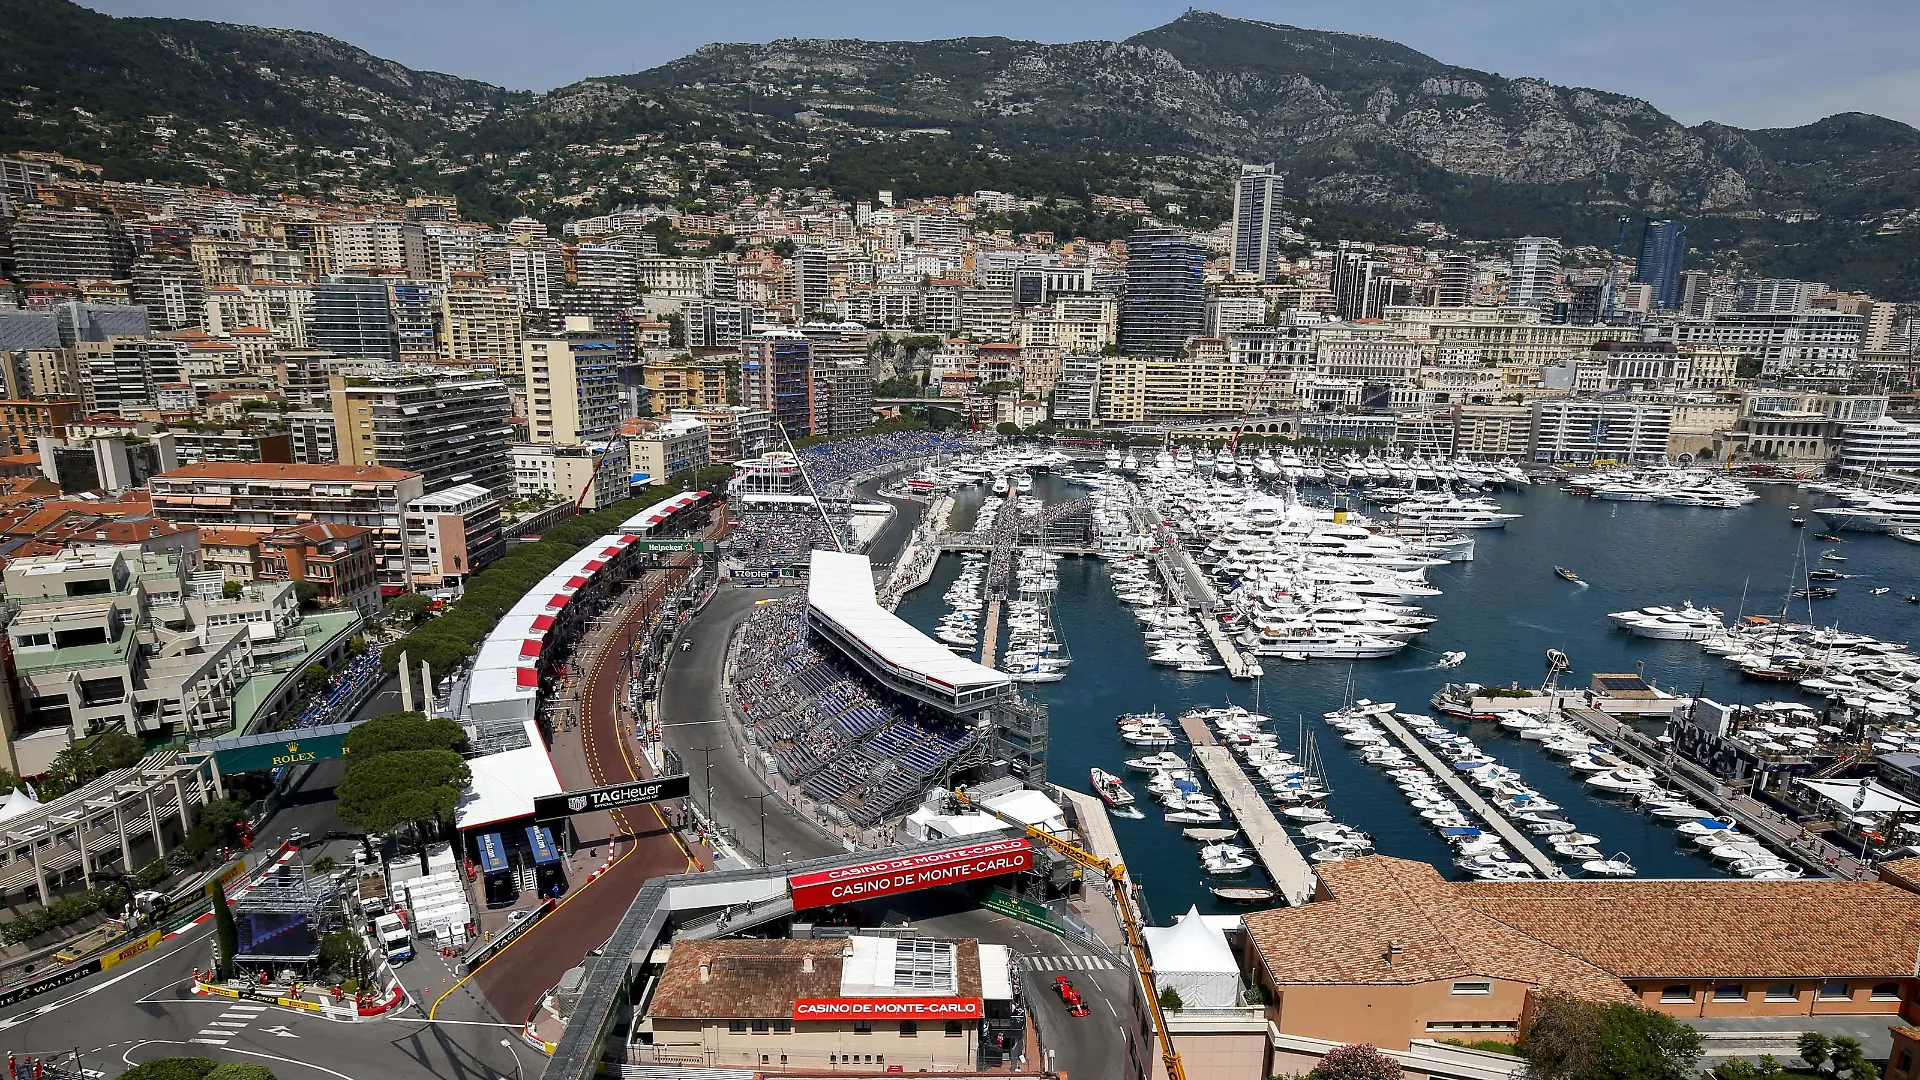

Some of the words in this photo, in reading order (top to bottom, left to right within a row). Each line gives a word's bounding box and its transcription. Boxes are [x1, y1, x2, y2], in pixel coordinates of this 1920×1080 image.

[272, 751, 315, 765] ROLEX
[828, 863, 888, 879] CASINO
[890, 858, 913, 869] DE
[914, 840, 1022, 864] MONTE-CARLO
[831, 878, 891, 898] CASINO
[894, 873, 915, 888] DE
[918, 855, 1025, 882] MONTE-CARLO
[33, 968, 90, 994] WALKER
[797, 1003, 850, 1013] CASINO
[852, 1003, 872, 1013] DE
[874, 1003, 976, 1013] MONTE-CARLO
